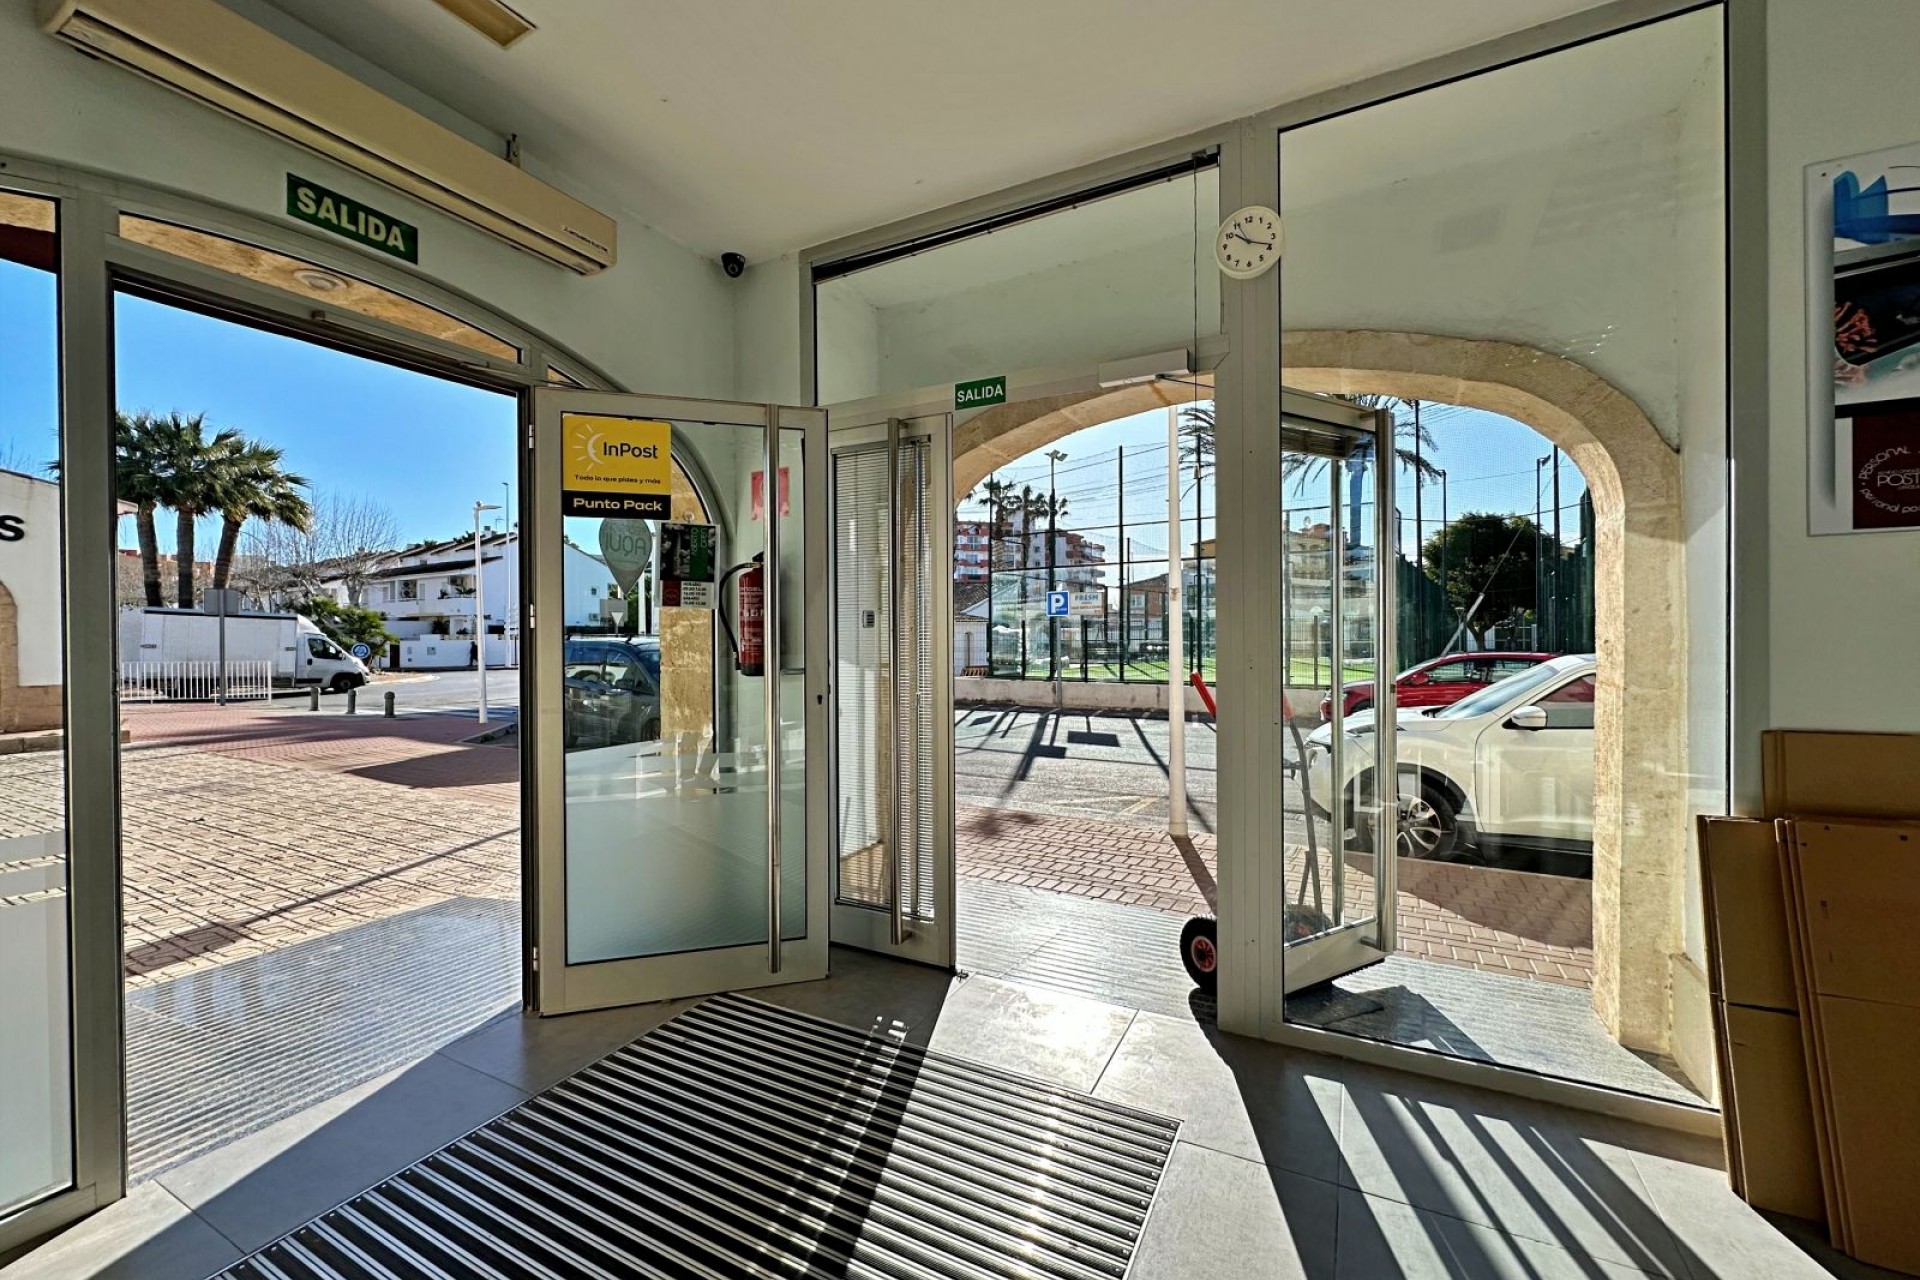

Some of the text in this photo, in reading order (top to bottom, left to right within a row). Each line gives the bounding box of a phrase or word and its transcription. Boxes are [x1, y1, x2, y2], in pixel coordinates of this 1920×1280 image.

[297, 186, 405, 252] SALIDA
[1244, 216, 1253, 224] 12
[1225, 232, 1234, 240] 10
[957, 384, 1004, 403] SALIDA
[603, 442, 658, 459] InPost
[618, 476, 637, 484] pides
[573, 498, 663, 511] Punto Pack
[1050, 593, 1065, 615] P
